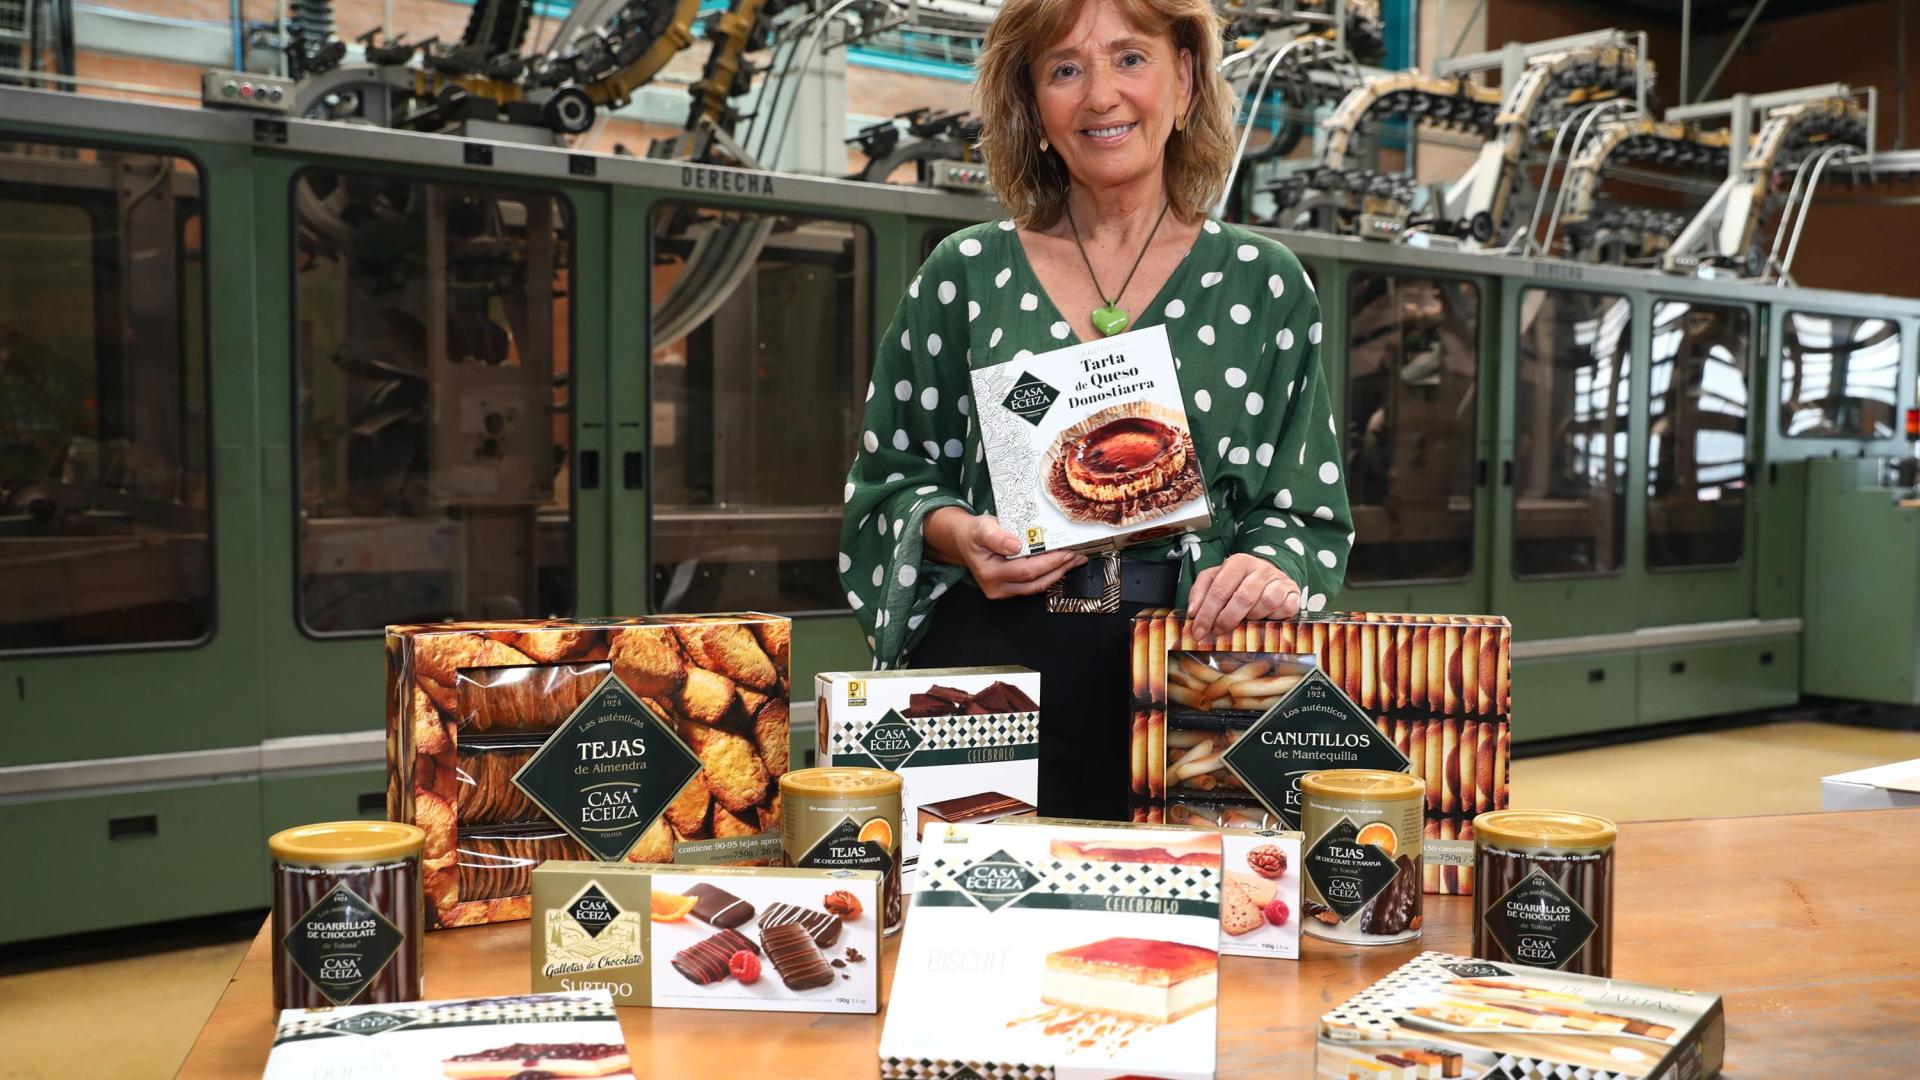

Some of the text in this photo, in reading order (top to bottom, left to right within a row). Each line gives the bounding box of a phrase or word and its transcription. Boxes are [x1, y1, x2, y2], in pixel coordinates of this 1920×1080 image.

[681, 166, 774, 196] DERECHA
[1080, 354, 1125, 372] Tarta
[1075, 367, 1139, 391] de Queso
[1013, 386, 1044, 400] CASA
[1068, 380, 1155, 409] Donostiarra
[1011, 394, 1050, 410] ECEIZA
[1307, 690, 1326, 698] 1924
[1282, 703, 1348, 720] Los auténticos
[579, 713, 644, 733] Las auténticas
[874, 729, 906, 740] CASA
[1261, 731, 1370, 748] CANUTILLOS
[576, 738, 646, 761] TEJAS
[870, 739, 911, 751] ECEIZA
[1274, 749, 1358, 762] de Mantequilla
[574, 760, 647, 775] de Almendra
[587, 790, 632, 808] CASA
[581, 804, 639, 823] ECEIZA
[678, 845, 712, 854] contiene
[714, 841, 738, 850] 90-95
[739, 839, 758, 849] tejas
[829, 846, 866, 858] TEJAS
[1328, 846, 1364, 860] TEJAS
[733, 850, 754, 858] 750g
[1440, 854, 1461, 863] 750g
[1322, 856, 1352, 866] CHOCOLATE
[973, 866, 1018, 879] CASA
[965, 876, 1024, 890] ECEIZA
[1331, 879, 1357, 890] CASA
[1328, 887, 1361, 899] ECEIZA
[579, 900, 608, 911] CASA
[576, 910, 612, 921] ECEIZA
[1506, 910, 1571, 921] DE CHOCOLATE
[306, 919, 376, 931] CIGARRILLOS
[1531, 923, 1552, 931] Tolosa
[307, 929, 376, 939] DE CHOCOLATE
[1521, 938, 1552, 949] CASA
[1517, 946, 1556, 959] ECEIZA
[324, 958, 357, 969] CASA
[545, 963, 584, 979] Galletas
[598, 954, 642, 969] Chocolate
[927, 948, 1011, 975] BISCUIT
[320, 968, 362, 979] ECEIZA
